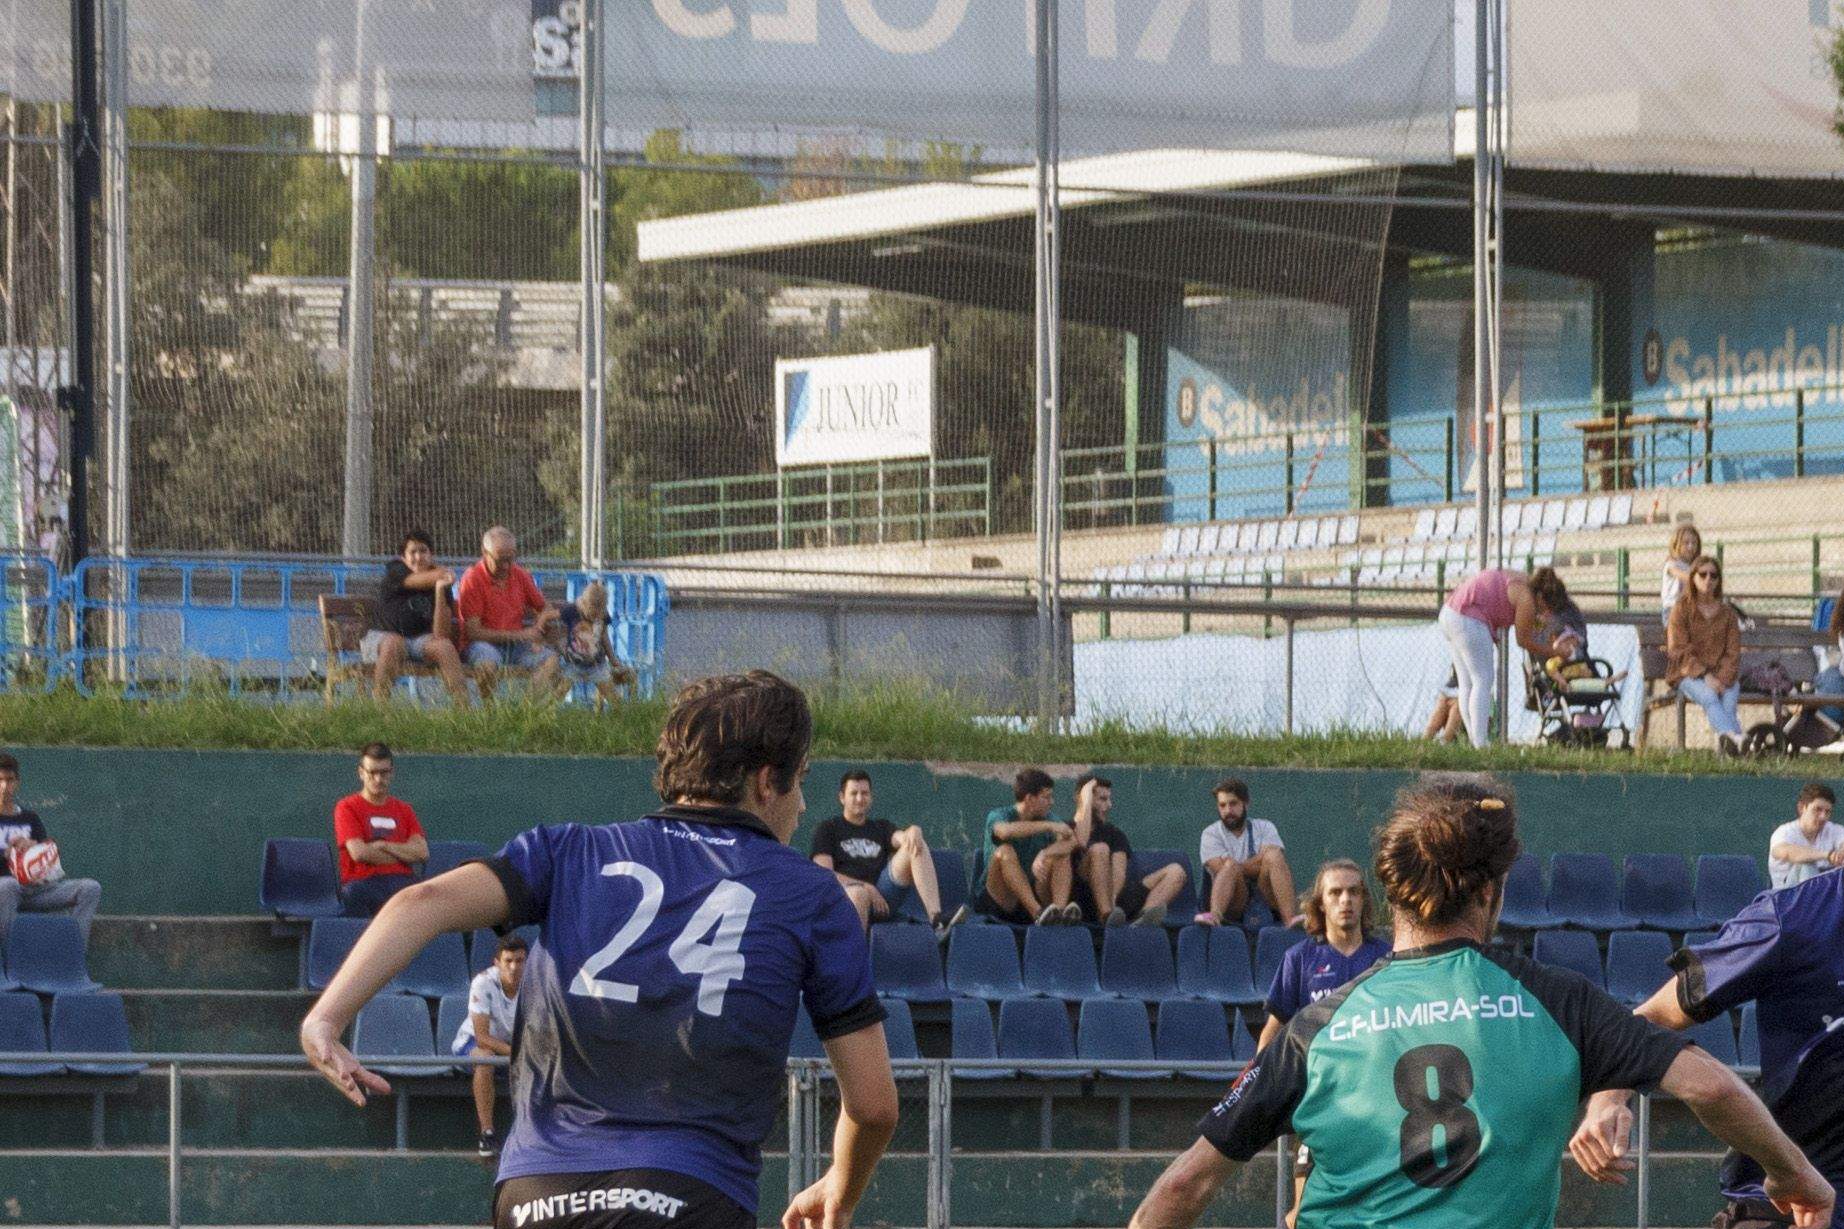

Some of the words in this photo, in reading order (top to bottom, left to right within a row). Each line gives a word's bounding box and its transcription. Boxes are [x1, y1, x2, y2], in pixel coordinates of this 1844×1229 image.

[816, 380, 899, 433] JUNIOR
[569, 861, 757, 1017] 24
[1393, 1043, 1482, 1189] 8
[532, 1187, 685, 1223] INTERSPORT
